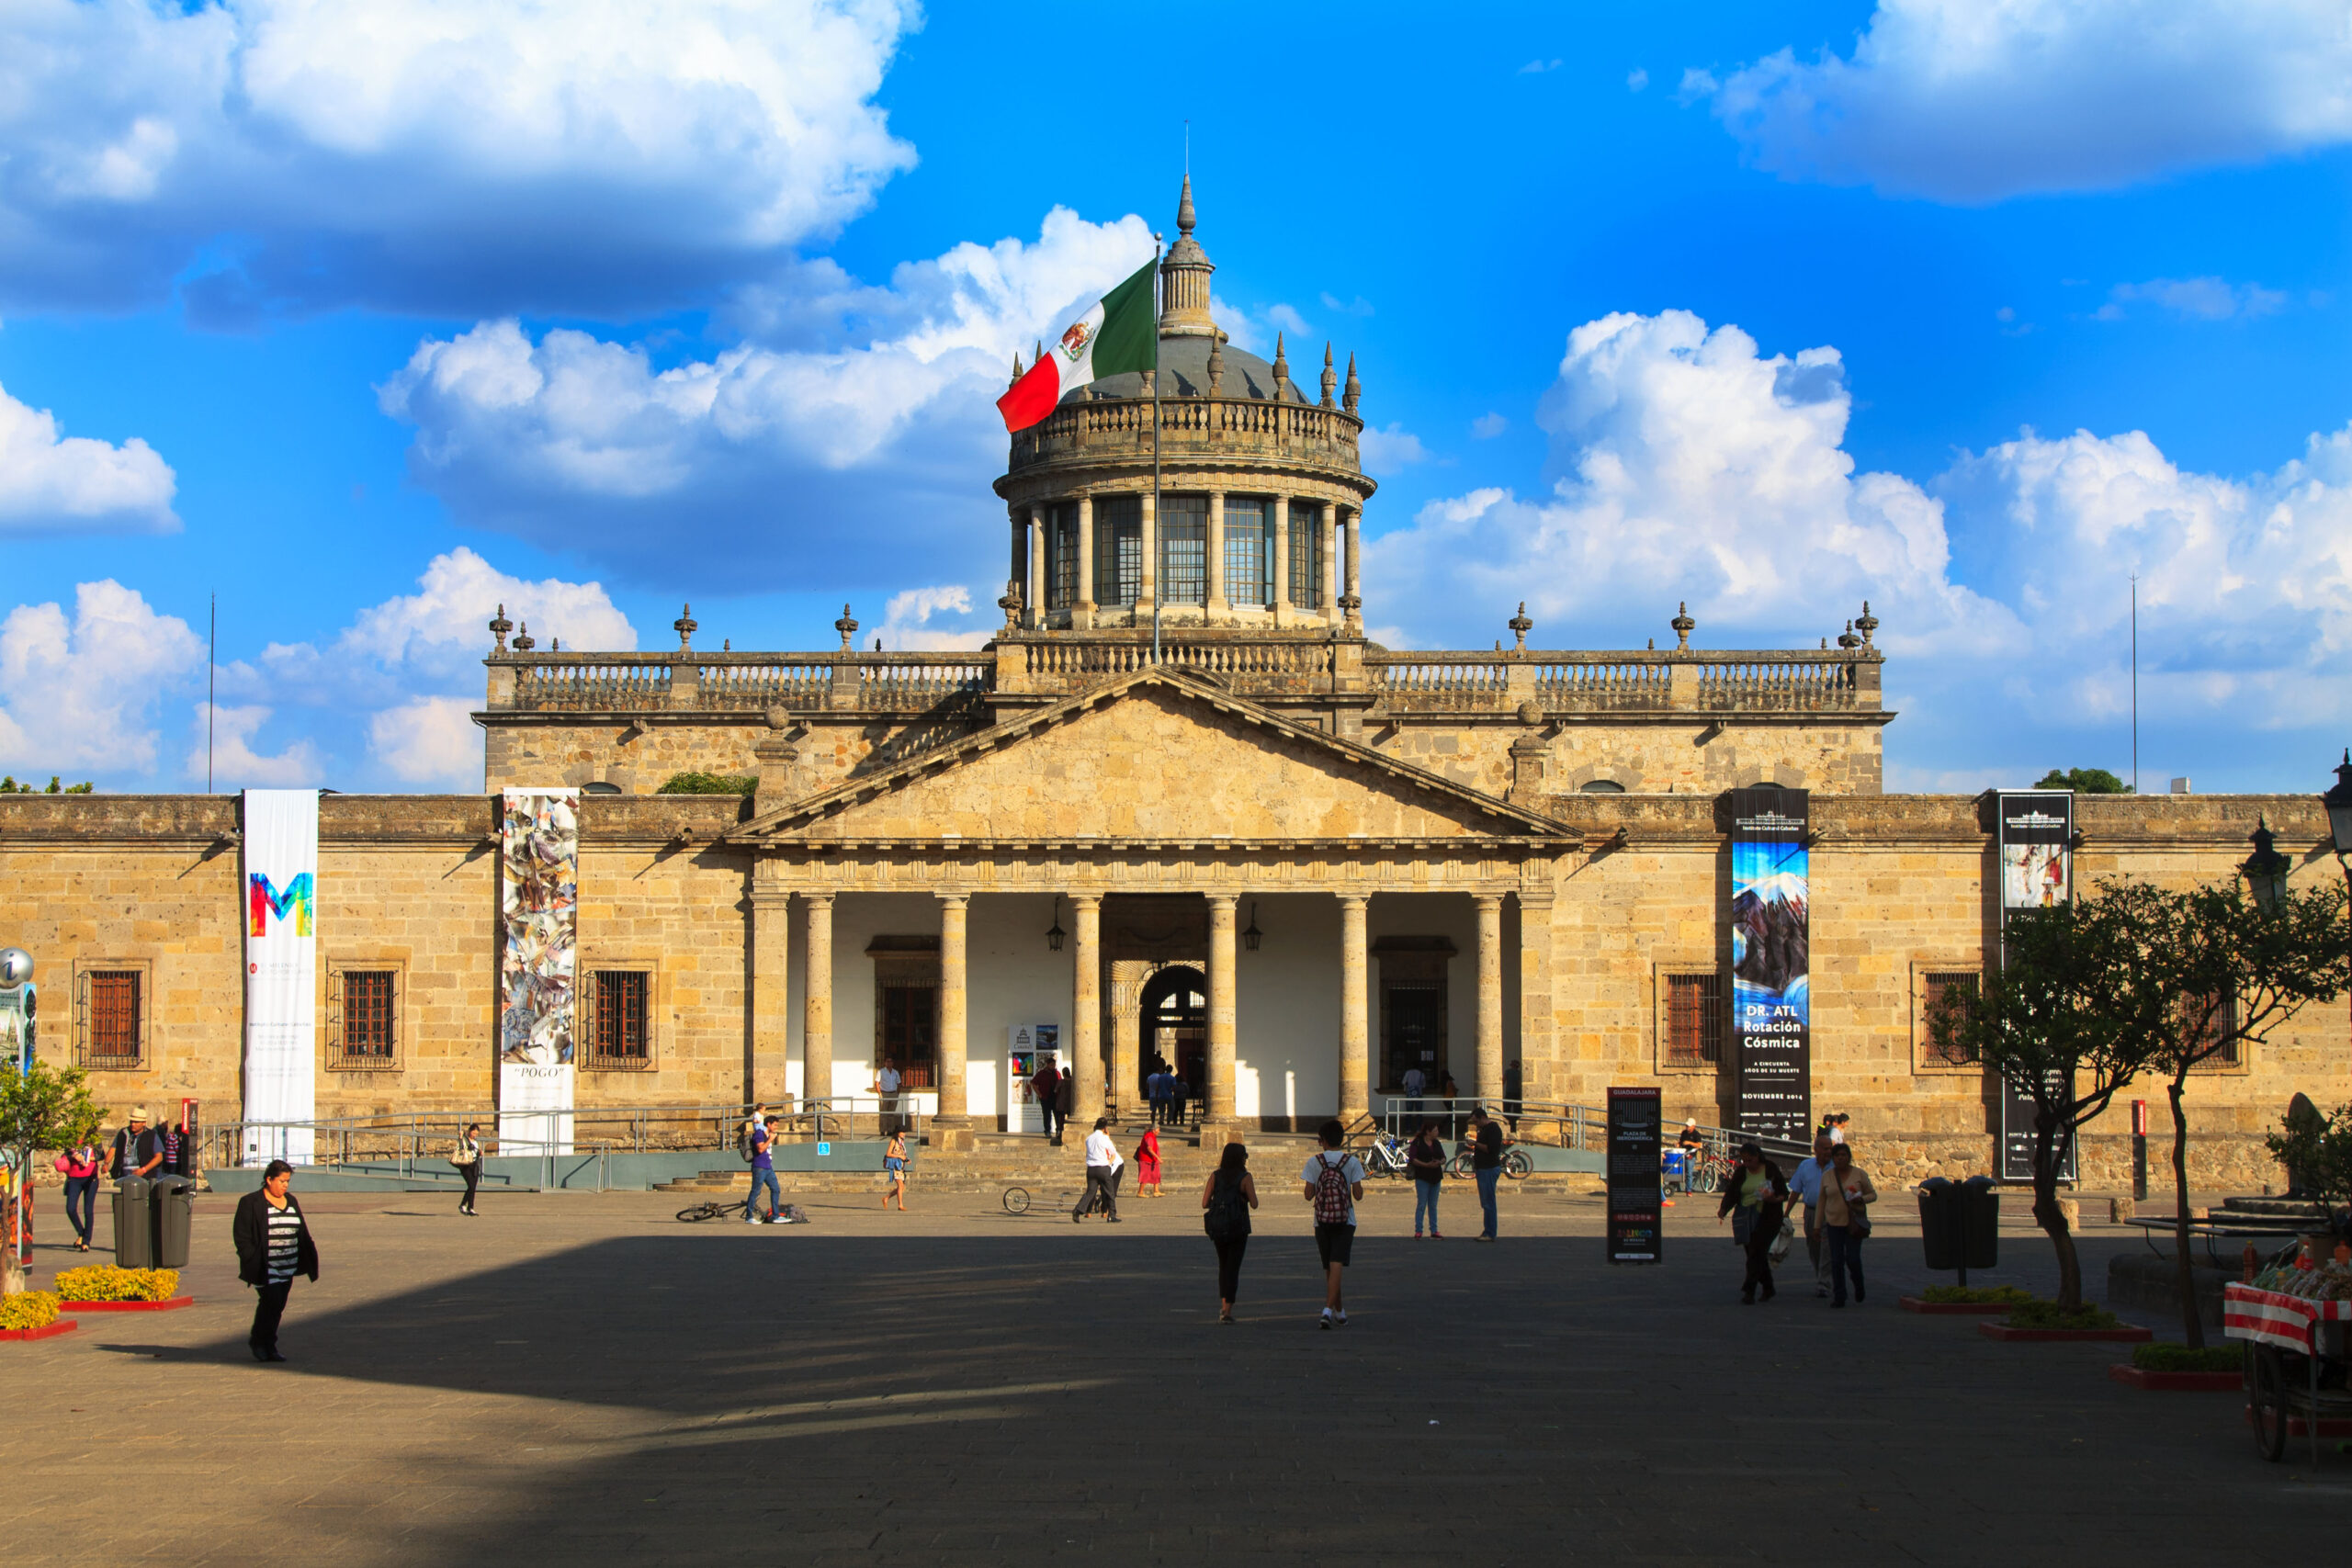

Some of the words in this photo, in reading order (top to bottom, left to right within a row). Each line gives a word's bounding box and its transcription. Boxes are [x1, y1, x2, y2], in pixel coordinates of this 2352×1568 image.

[250, 873, 313, 937] M
[1747, 1006, 1770, 1016] DR.
[1773, 1006, 1798, 1016] ATL
[1744, 1021, 1801, 1032] Rotación
[1744, 1036, 1801, 1048] Cósmica
